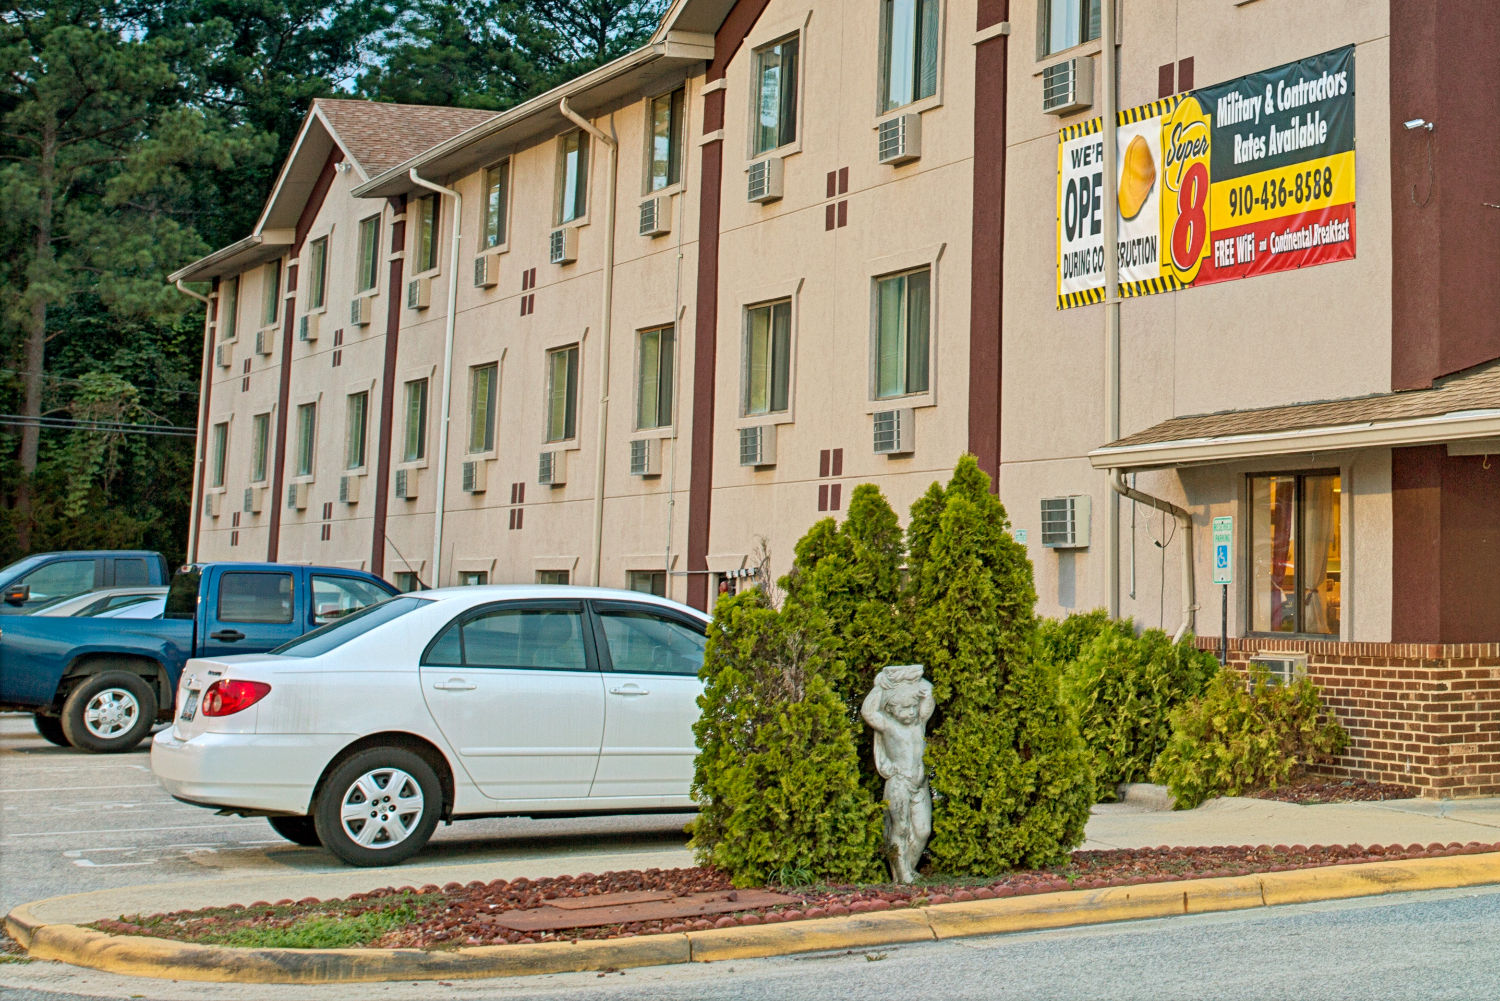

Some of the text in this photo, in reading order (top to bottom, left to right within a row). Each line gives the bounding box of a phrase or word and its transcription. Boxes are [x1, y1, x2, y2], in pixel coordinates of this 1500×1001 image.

[1217, 71, 1347, 128] Military & Contractors
[1071, 141, 1103, 169] WE'R
[1166, 121, 1210, 185] Super
[1234, 111, 1327, 164] Rates Available
[1065, 172, 1103, 242] OPE
[1171, 162, 1208, 271] 8
[1229, 166, 1333, 218] 910-436-8588
[1064, 235, 1157, 279] DURING CORUCTION
[1214, 238, 1235, 268] FREE
[1236, 232, 1256, 264] WiFi
[1269, 225, 1312, 255] Continental
[1312, 218, 1350, 247] Breakfast
